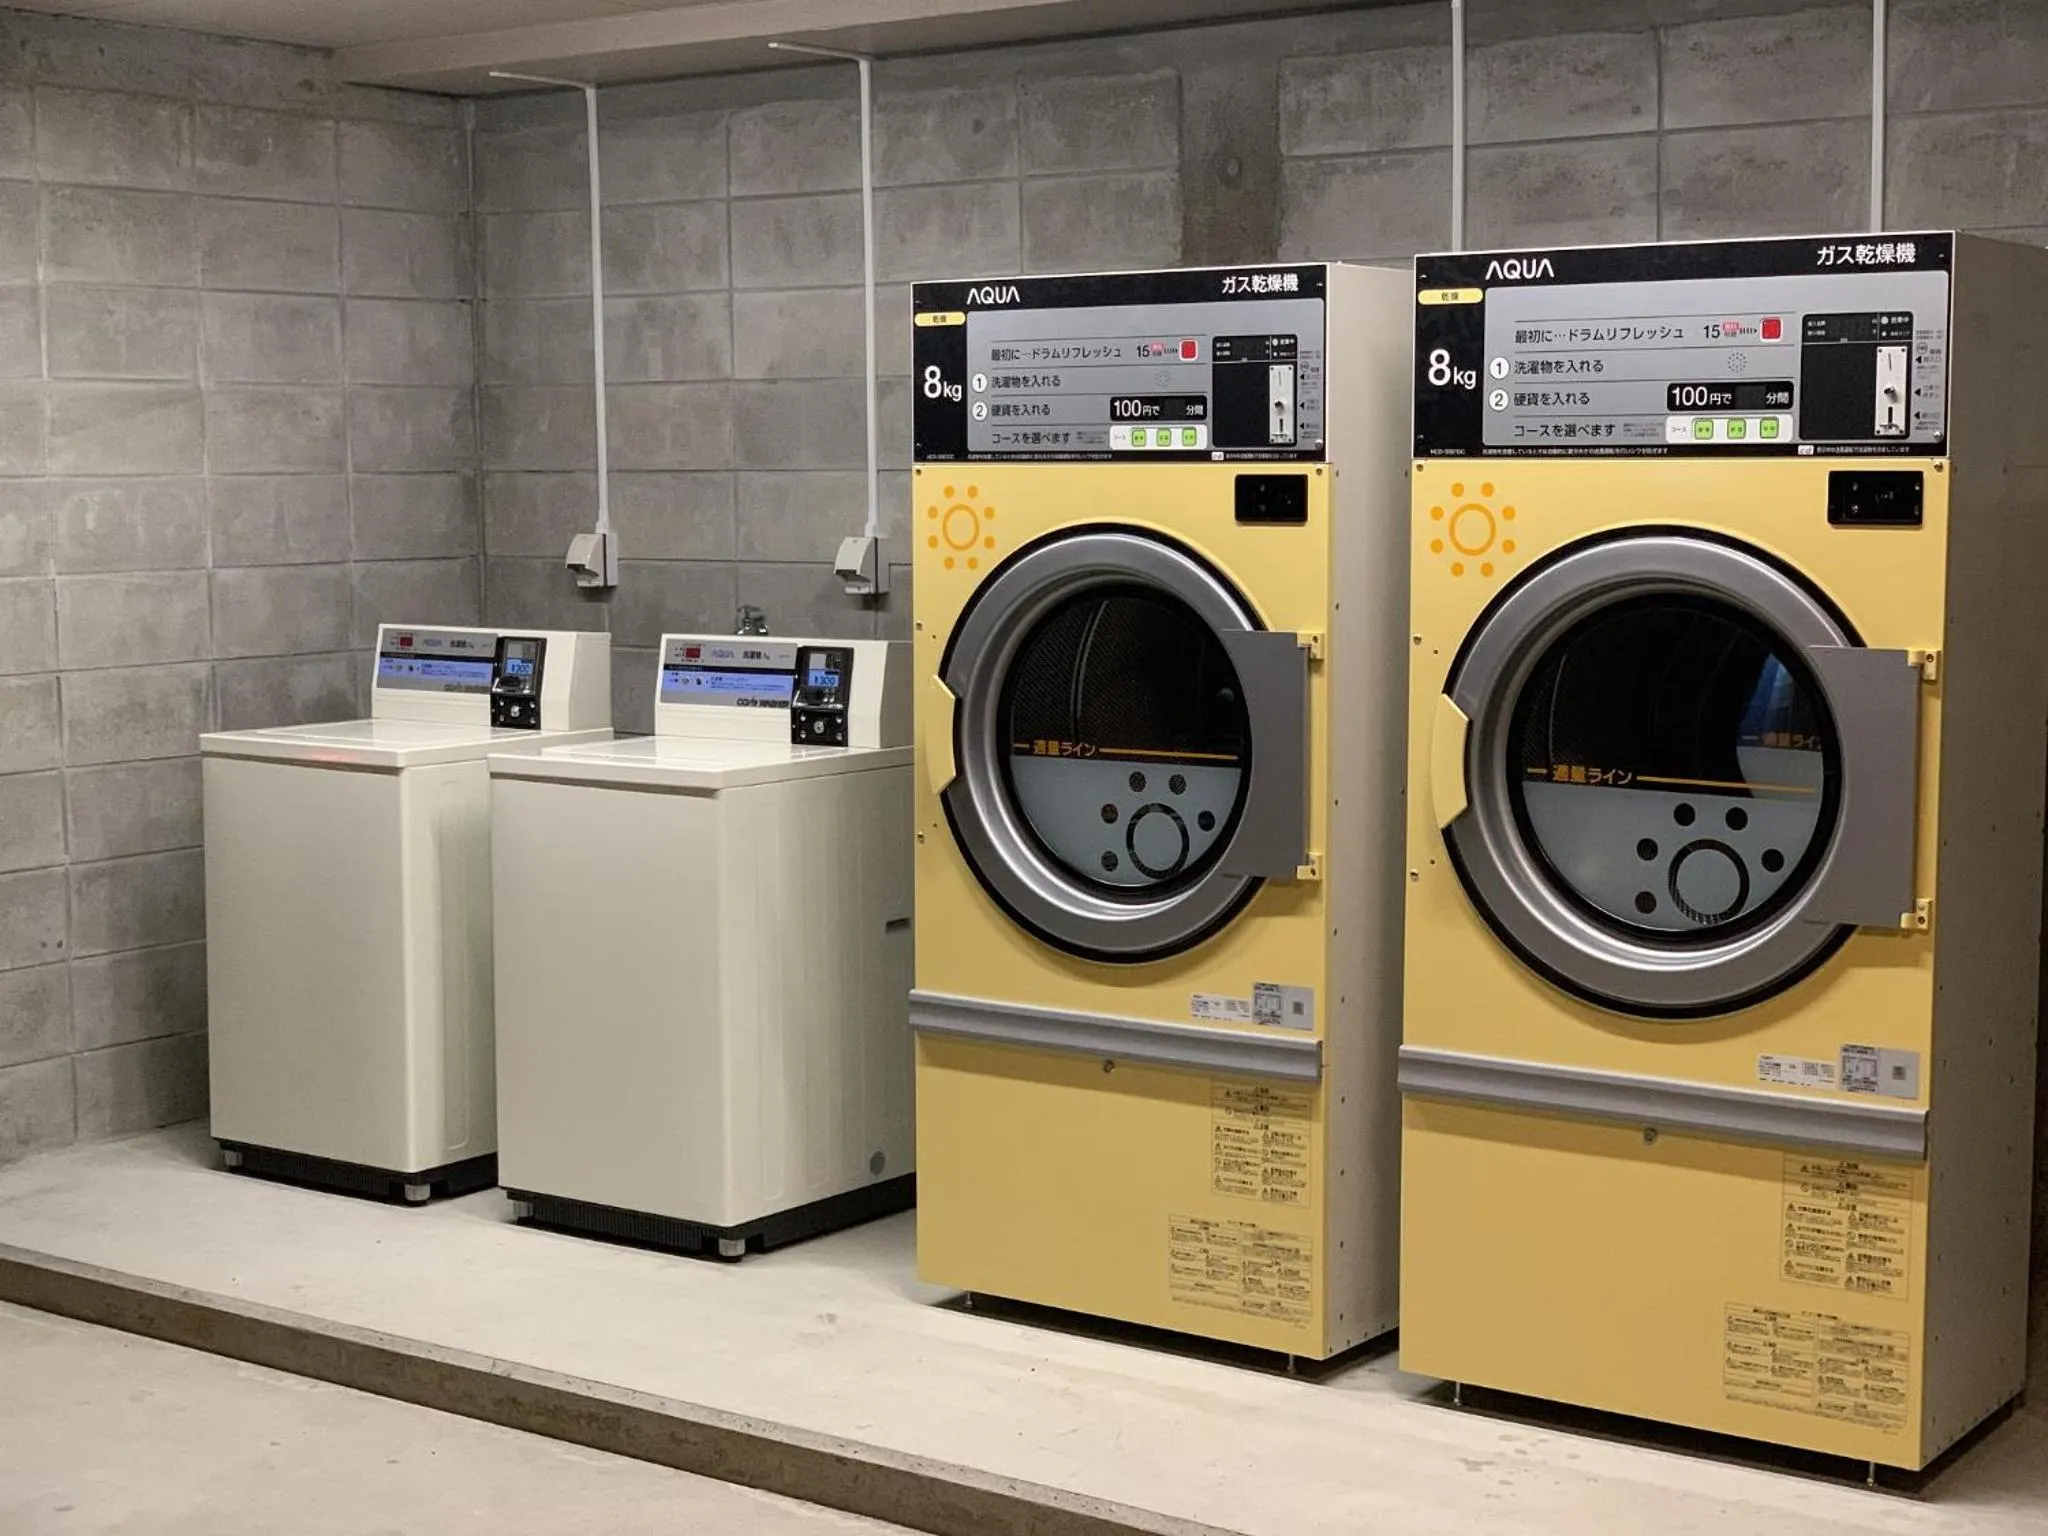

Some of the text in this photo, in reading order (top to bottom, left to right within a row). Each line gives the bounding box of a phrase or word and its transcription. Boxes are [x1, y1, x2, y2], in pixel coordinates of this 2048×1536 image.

[1815, 242, 1917, 266] ガス乾燥機
[1485, 258, 1555, 280] AQUA
[1221, 274, 1299, 294] ガス乾燥機
[967, 286, 1020, 305] AQUA
[1703, 324, 1721, 339] 15
[1136, 345, 1150, 357] 15
[1428, 348, 1477, 389] 8kg
[1514, 359, 1604, 375] 洗濯物を入れる
[924, 365, 962, 401] 8kg
[991, 375, 1061, 389] 洗濯物を入れる
[1514, 391, 1591, 407] 硬貨を入れる
[1766, 391, 1789, 405] 分間
[992, 431, 1071, 444] コースを選べます
[1514, 424, 1616, 438] コースを選べます
